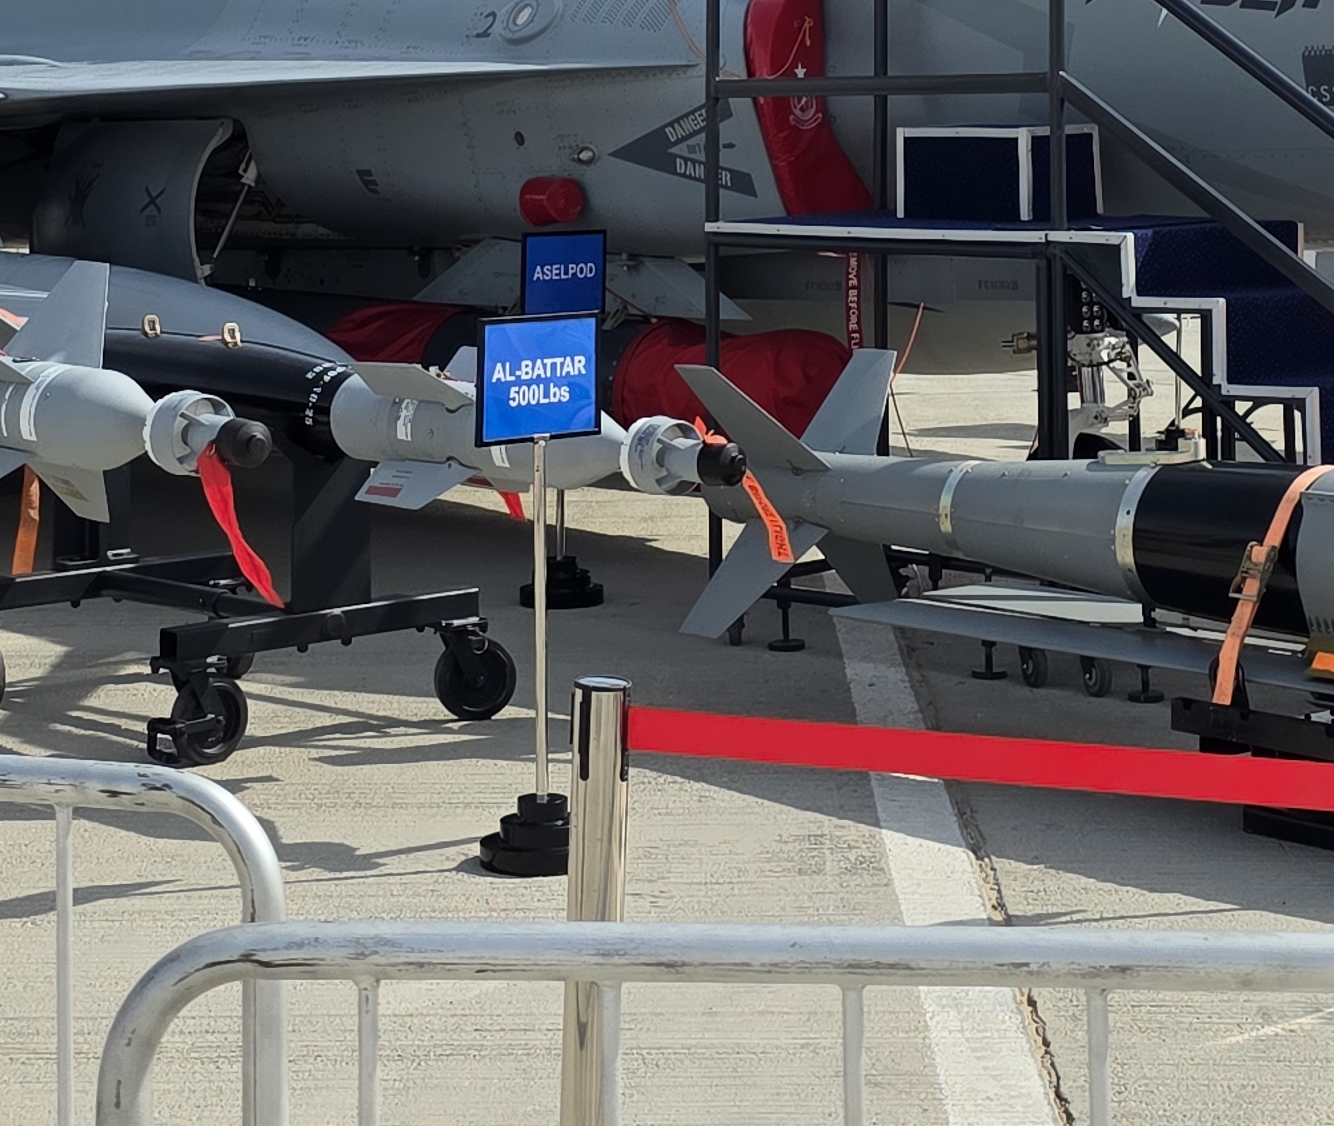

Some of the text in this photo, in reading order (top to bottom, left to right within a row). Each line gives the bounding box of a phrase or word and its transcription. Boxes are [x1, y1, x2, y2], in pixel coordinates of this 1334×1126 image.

[474, 10, 498, 39] 2
[676, 157, 731, 187] DANR
[533, 262, 596, 282] ASELPOD
[848, 289, 859, 331] BEFORE
[491, 355, 586, 383] AL-BATTAR
[509, 382, 570, 408] 500Lbs
